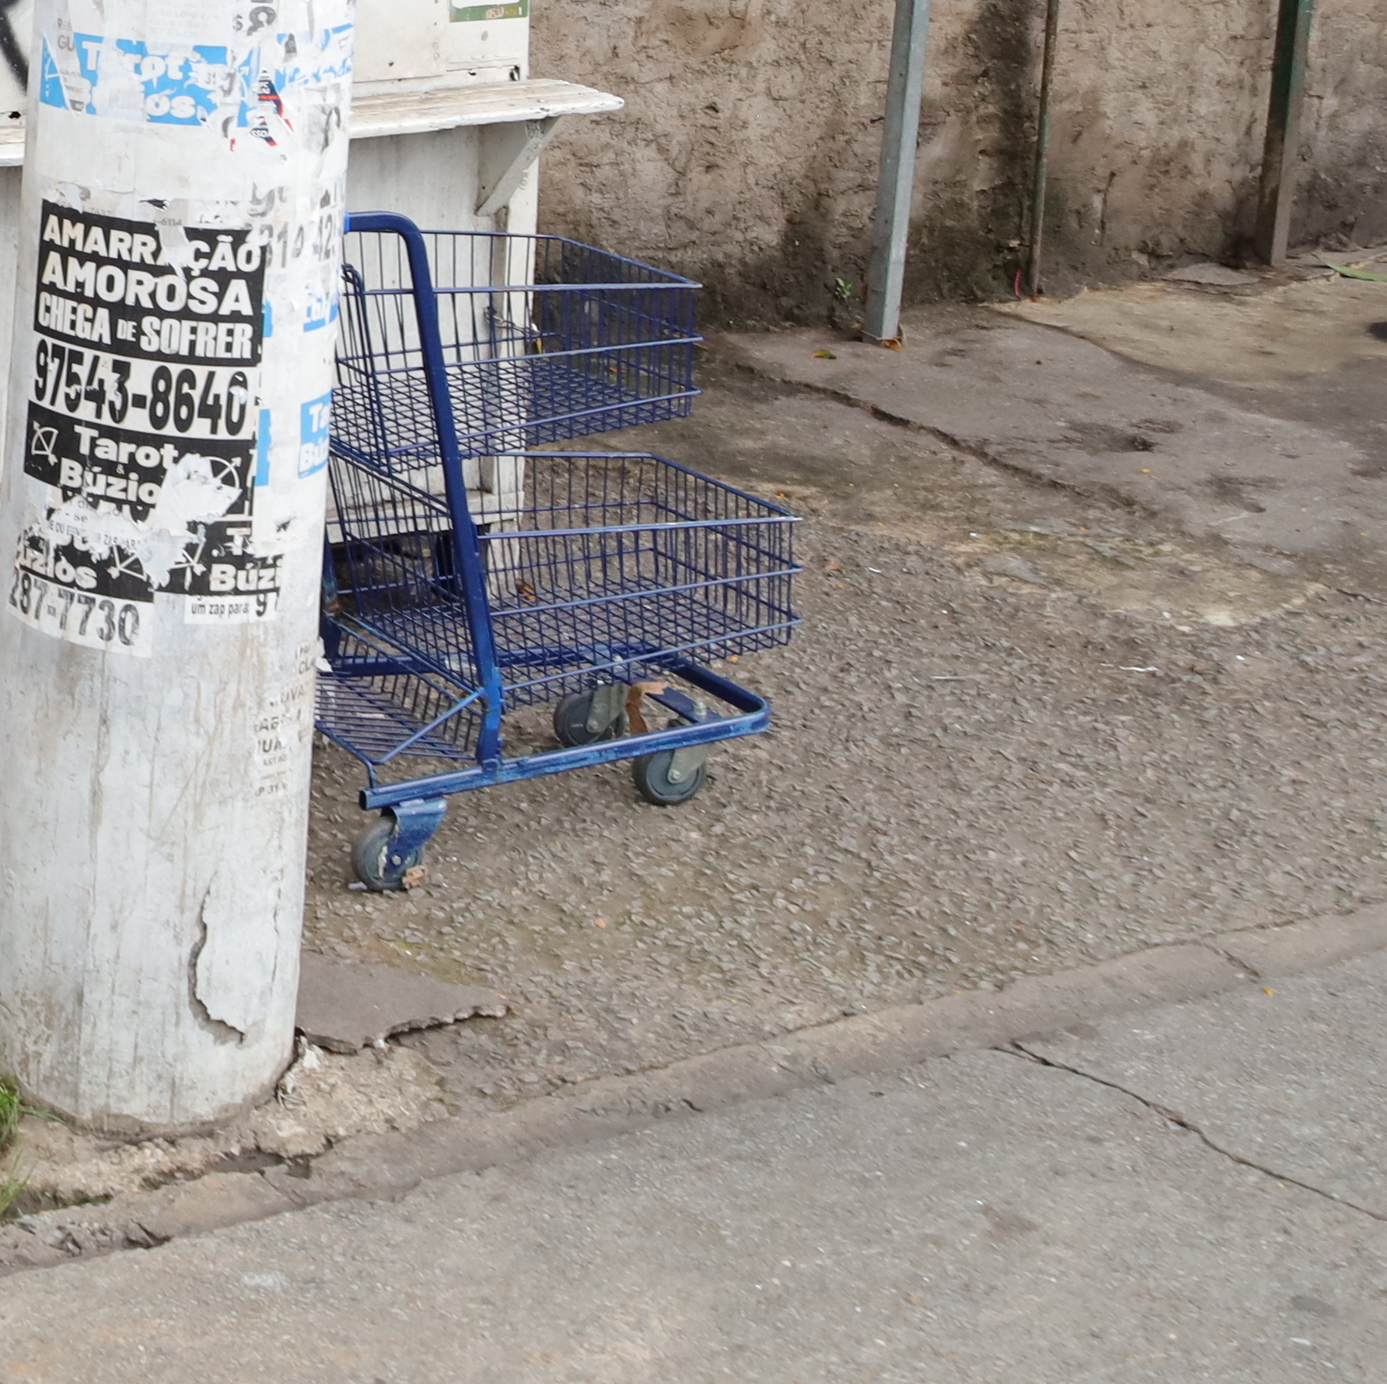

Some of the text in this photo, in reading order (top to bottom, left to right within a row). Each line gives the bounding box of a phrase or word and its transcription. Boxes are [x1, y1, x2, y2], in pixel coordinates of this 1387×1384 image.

[41, 250, 254, 316] AMOROSA
[38, 291, 254, 359] CHEGA DE SOFRER
[35, 338, 249, 436] 97543-8640
[74, 424, 179, 470] Tarot
[59, 458, 162, 504] Búzio
[191, 603, 206, 615] um
[209, 603, 225, 618] zap
